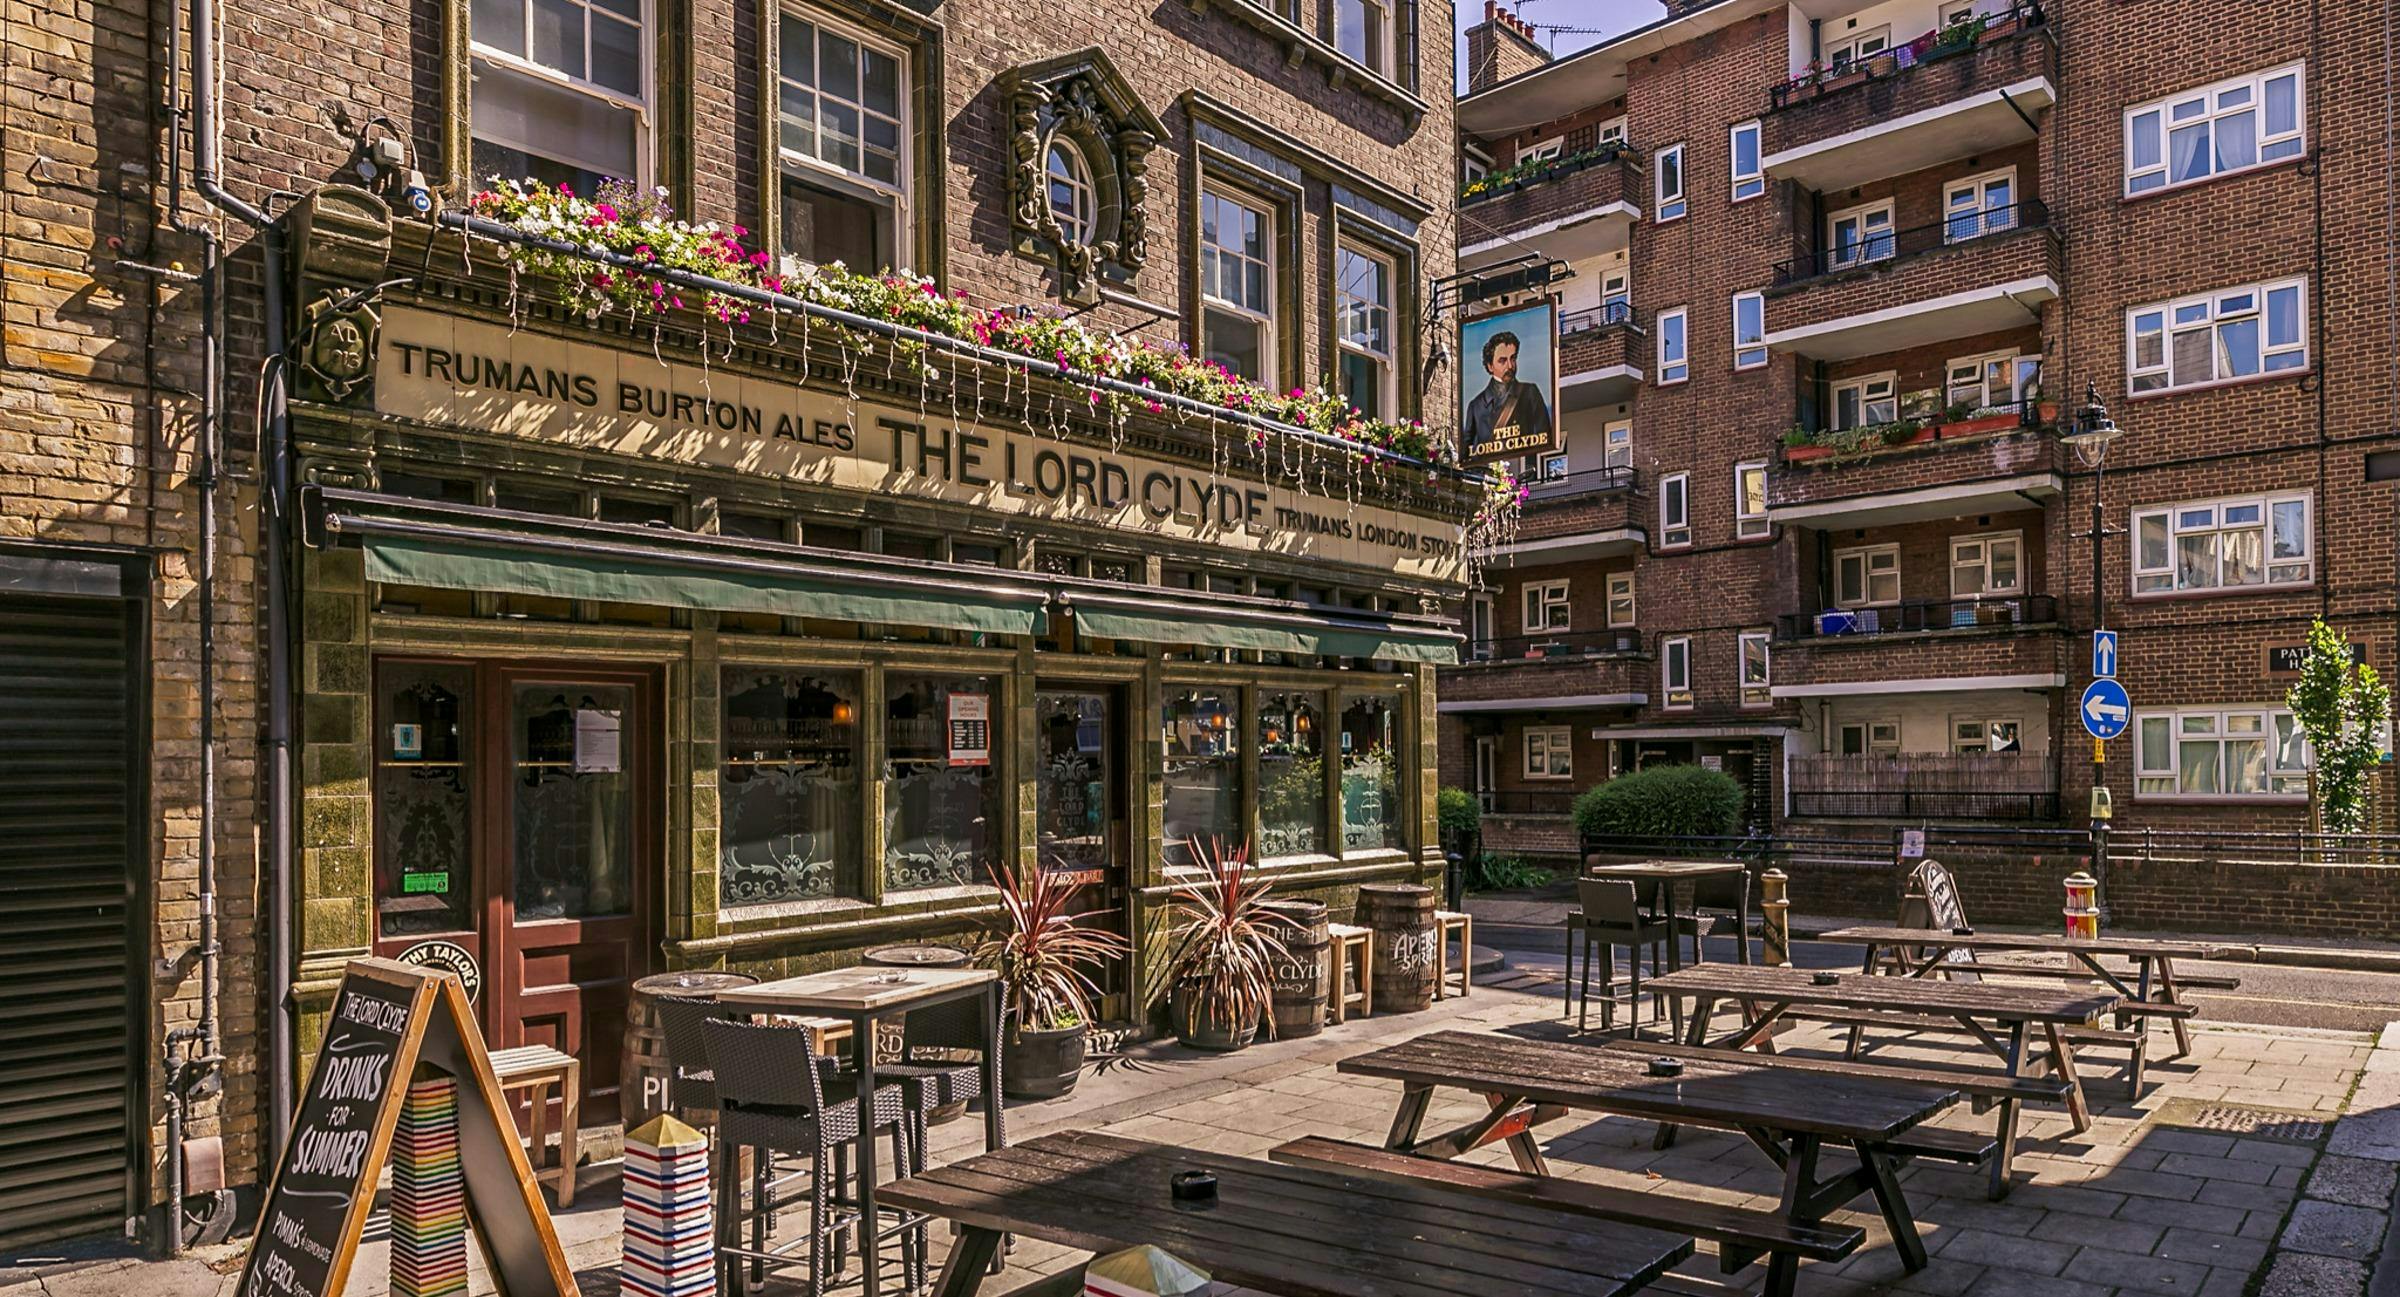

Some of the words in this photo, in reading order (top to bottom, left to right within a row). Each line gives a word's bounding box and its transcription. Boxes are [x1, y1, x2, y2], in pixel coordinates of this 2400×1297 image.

[391, 341, 599, 408] TRUMANS
[618, 382, 762, 437] BURTON
[775, 413, 855, 452] ALES
[1468, 441, 1503, 457] LORD
[1505, 432, 1548, 451] CLYDE
[1493, 424, 1521, 440] THE
[877, 417, 991, 487] THE
[1006, 441, 1130, 510] LORD
[1142, 472, 1270, 535] CLYDE
[1275, 507, 1352, 539] TRUMANS
[1357, 522, 1417, 551] LONDON
[1420, 535, 1462, 561] STOUT
[433, 945, 479, 987] TAYLOR'S
[1394, 927, 1437, 960] APERO
[343, 992, 361, 1018] THE
[355, 996, 381, 1024] LORD
[376, 1001, 408, 1032] CLYDE
[319, 1053, 390, 1102] DRINKS
[291, 1123, 369, 1179] SUMMER
[264, 1249, 296, 1294] APEROL
